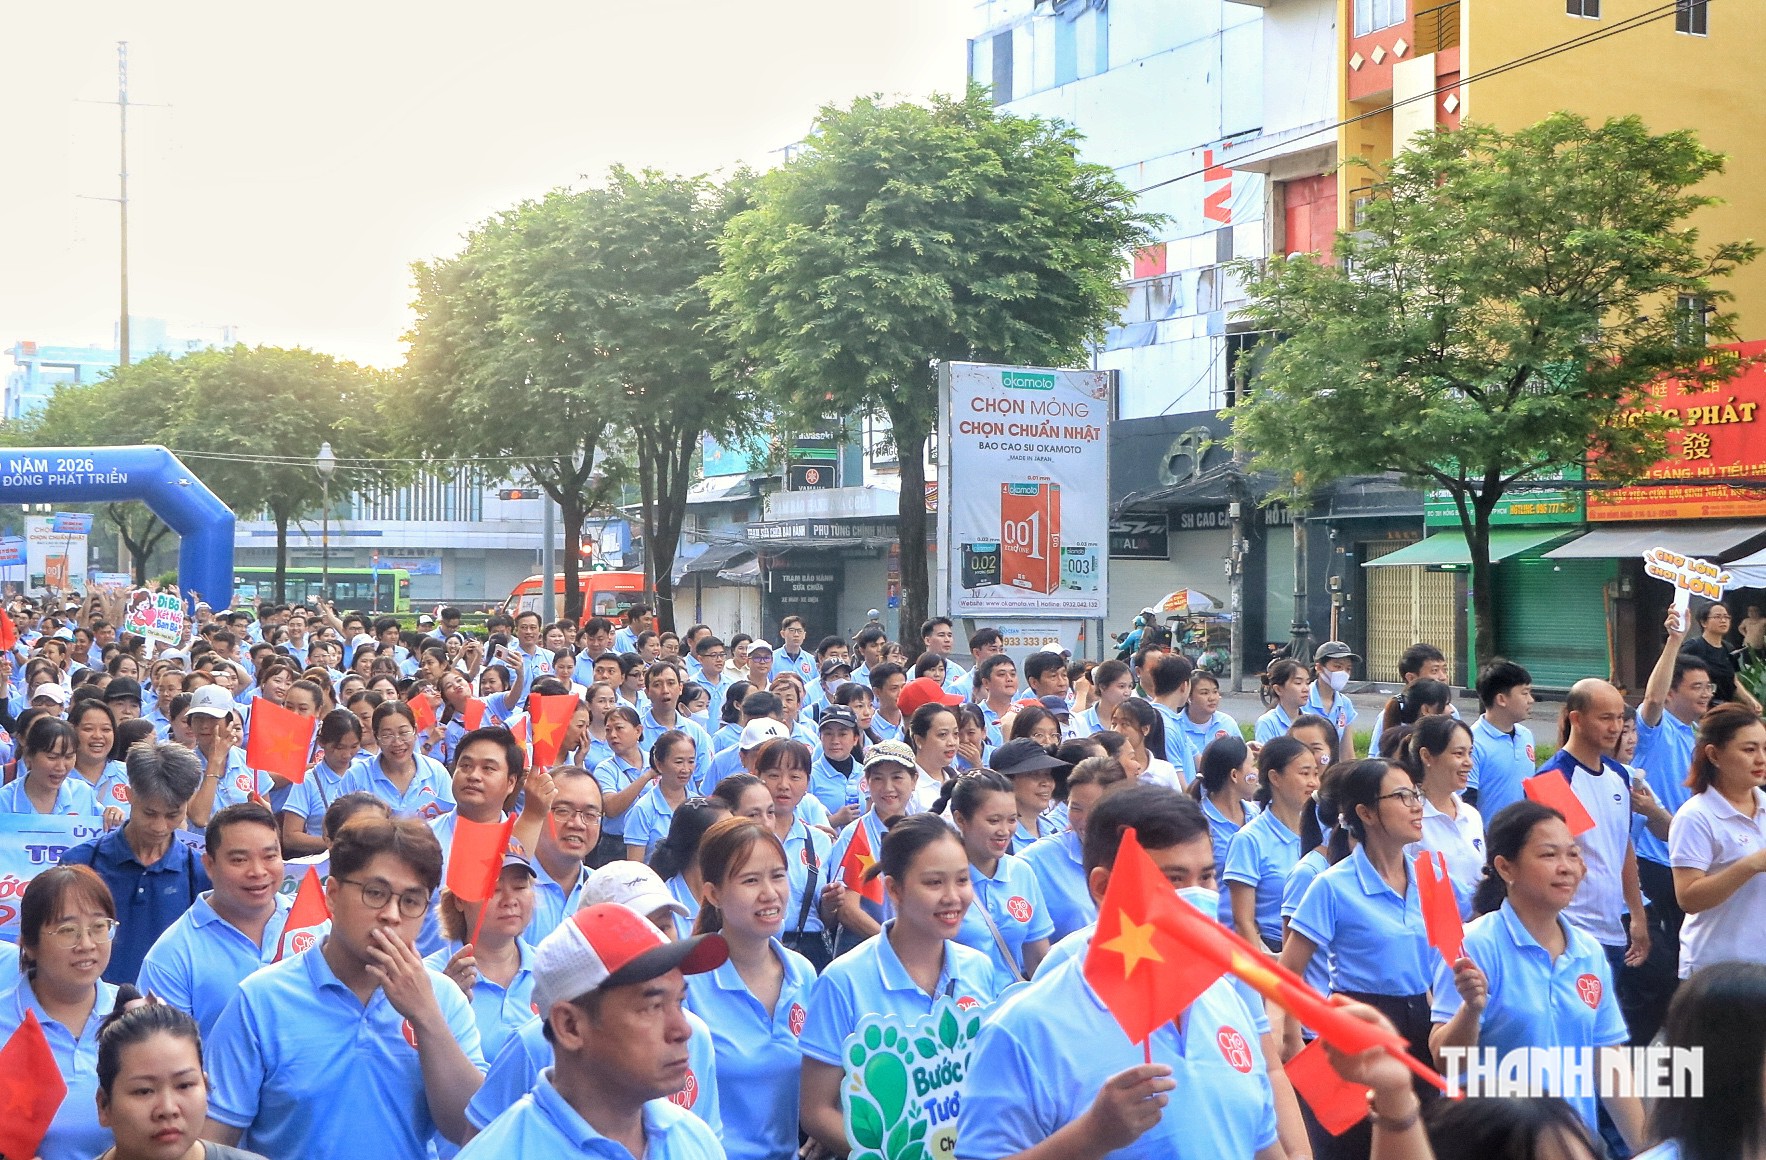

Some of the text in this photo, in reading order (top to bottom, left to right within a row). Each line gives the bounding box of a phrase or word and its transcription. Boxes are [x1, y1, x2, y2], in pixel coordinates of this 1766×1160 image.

[1003, 371, 1053, 389] okamoto
[971, 396, 1089, 418] CHỌN MỎNG
[1686, 396, 1757, 427] PHÁT
[959, 419, 1101, 443] CHỌN CHUẨN NHẬT
[979, 441, 1082, 454] BAO CAO SU OKAMOTO
[10, 457, 94, 473] NĂM 2026
[3, 467, 128, 487] ĐỒNG PHÁT TRIỂN
[1181, 513, 1194, 528] SH
[1196, 512, 1216, 527] CAO
[813, 525, 829, 539] PHỤ
[831, 523, 850, 536] TÙNG
[1687, 560, 1718, 579] LỚN
[1678, 575, 1721, 600] LỚN
[157, 595, 168, 608] Đi
[1023, 637, 1040, 646] 333
[912, 1056, 964, 1098] Bước
